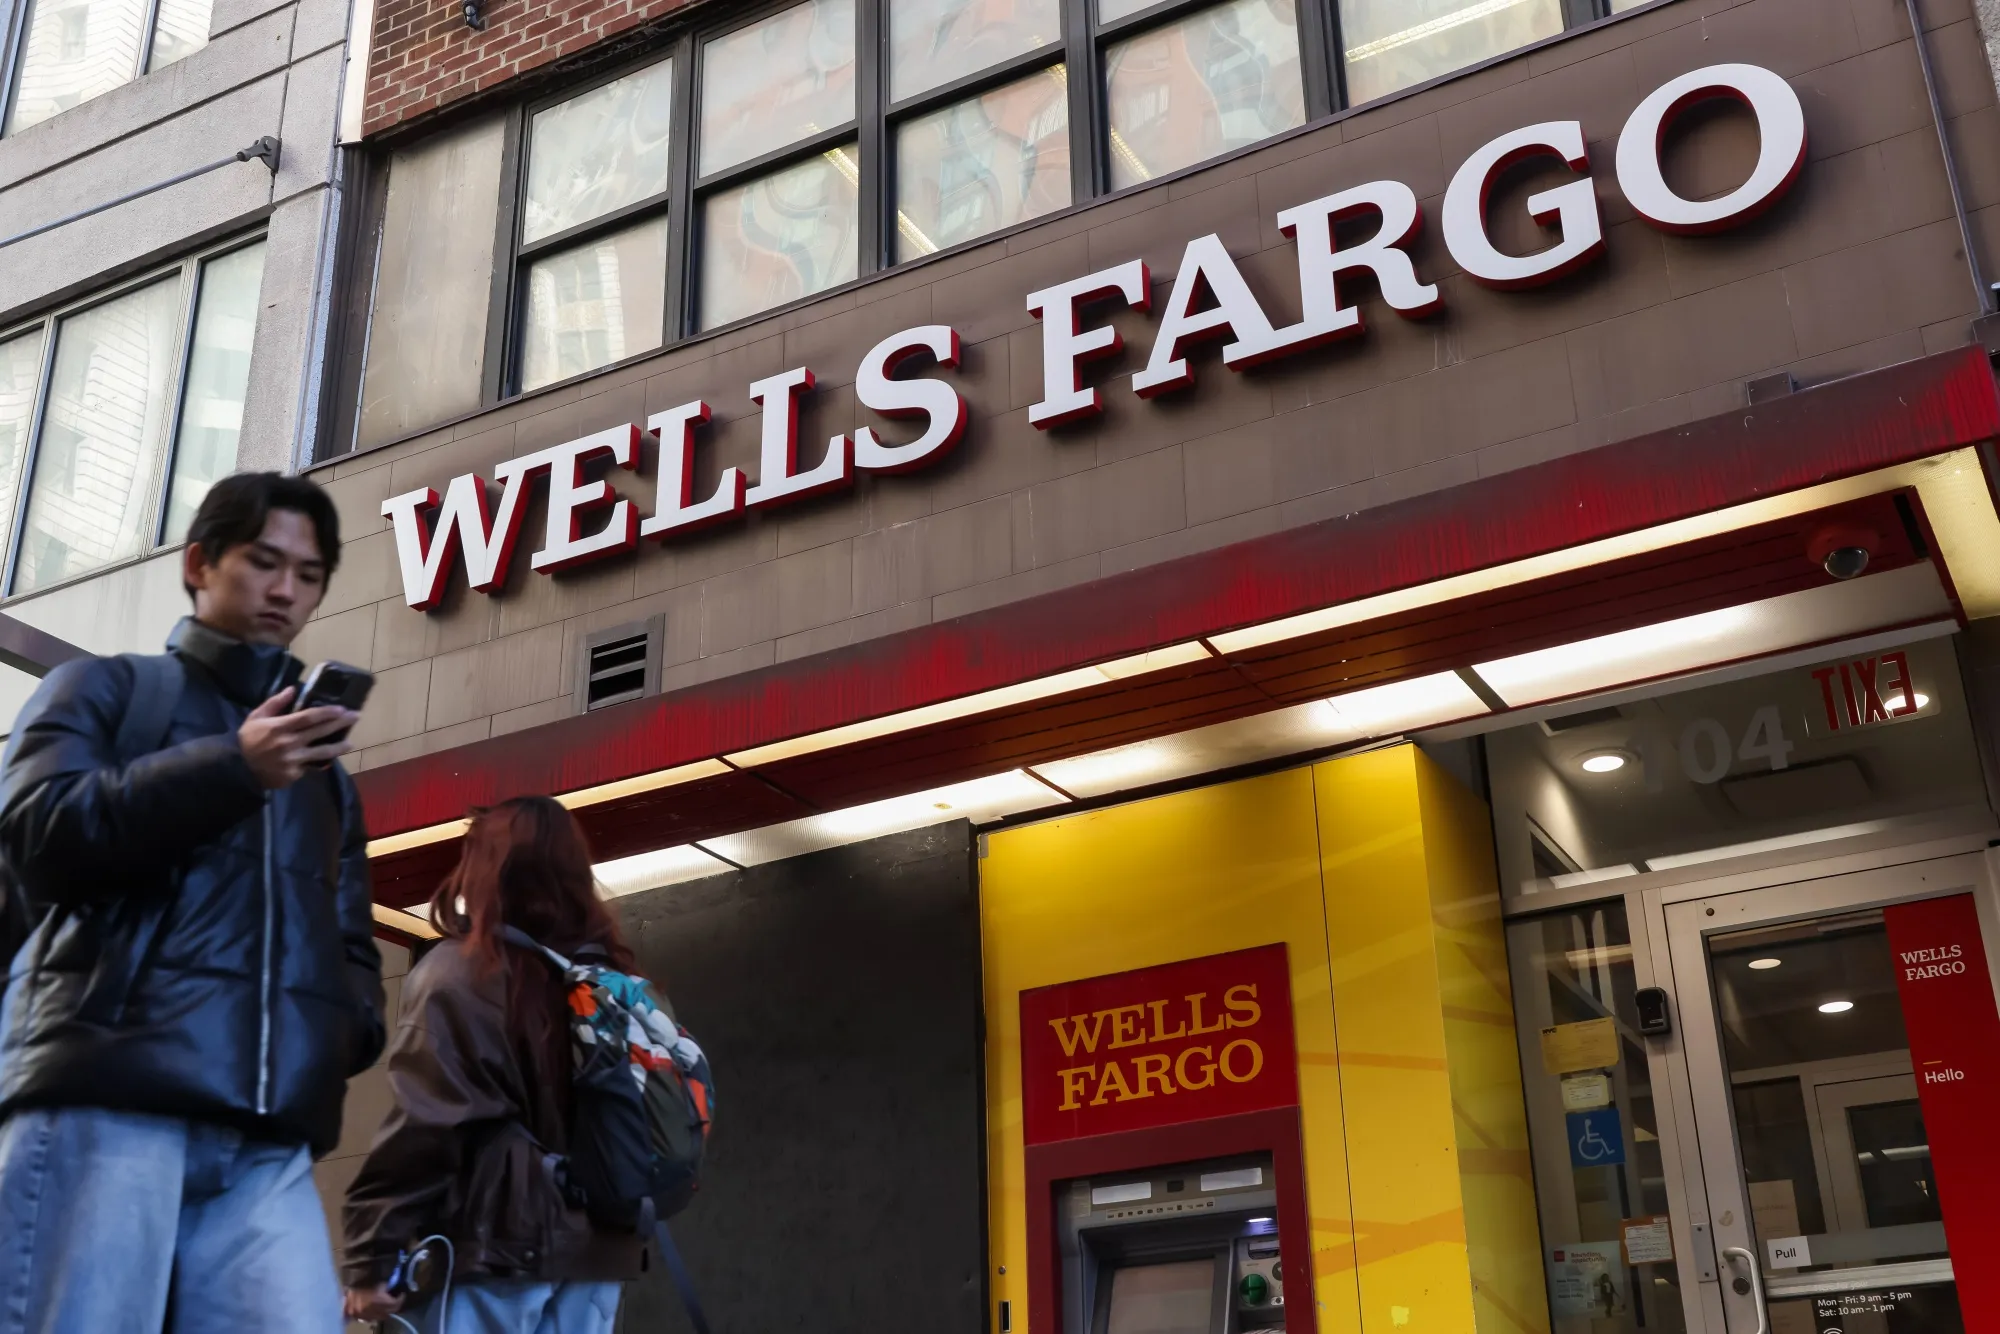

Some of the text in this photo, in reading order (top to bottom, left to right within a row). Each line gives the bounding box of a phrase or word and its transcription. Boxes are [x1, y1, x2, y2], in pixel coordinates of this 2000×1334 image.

[381, 62, 1809, 612] WELLS FARGO
[1900, 944, 1962, 965] WELLS
[1905, 961, 1966, 981] FARGO
[1048, 983, 1262, 1058] WELLS
[1056, 1038, 1264, 1112] FARGO
[1924, 1068, 1965, 1084] Hello
[1775, 1247, 1797, 1259] Pull
[1817, 1299, 1837, 1307] Mon
[1845, 1295, 1859, 1304] Fri:
[1859, 1295, 1866, 1303] 9
[1889, 1292, 1896, 1300] 5
[1897, 1292, 1912, 1301] pm
[1819, 1309, 1837, 1317] Sat:
[1838, 1307, 1849, 1316] 10
[1872, 1304, 1879, 1312] 1
[1880, 1304, 1895, 1313] pm
